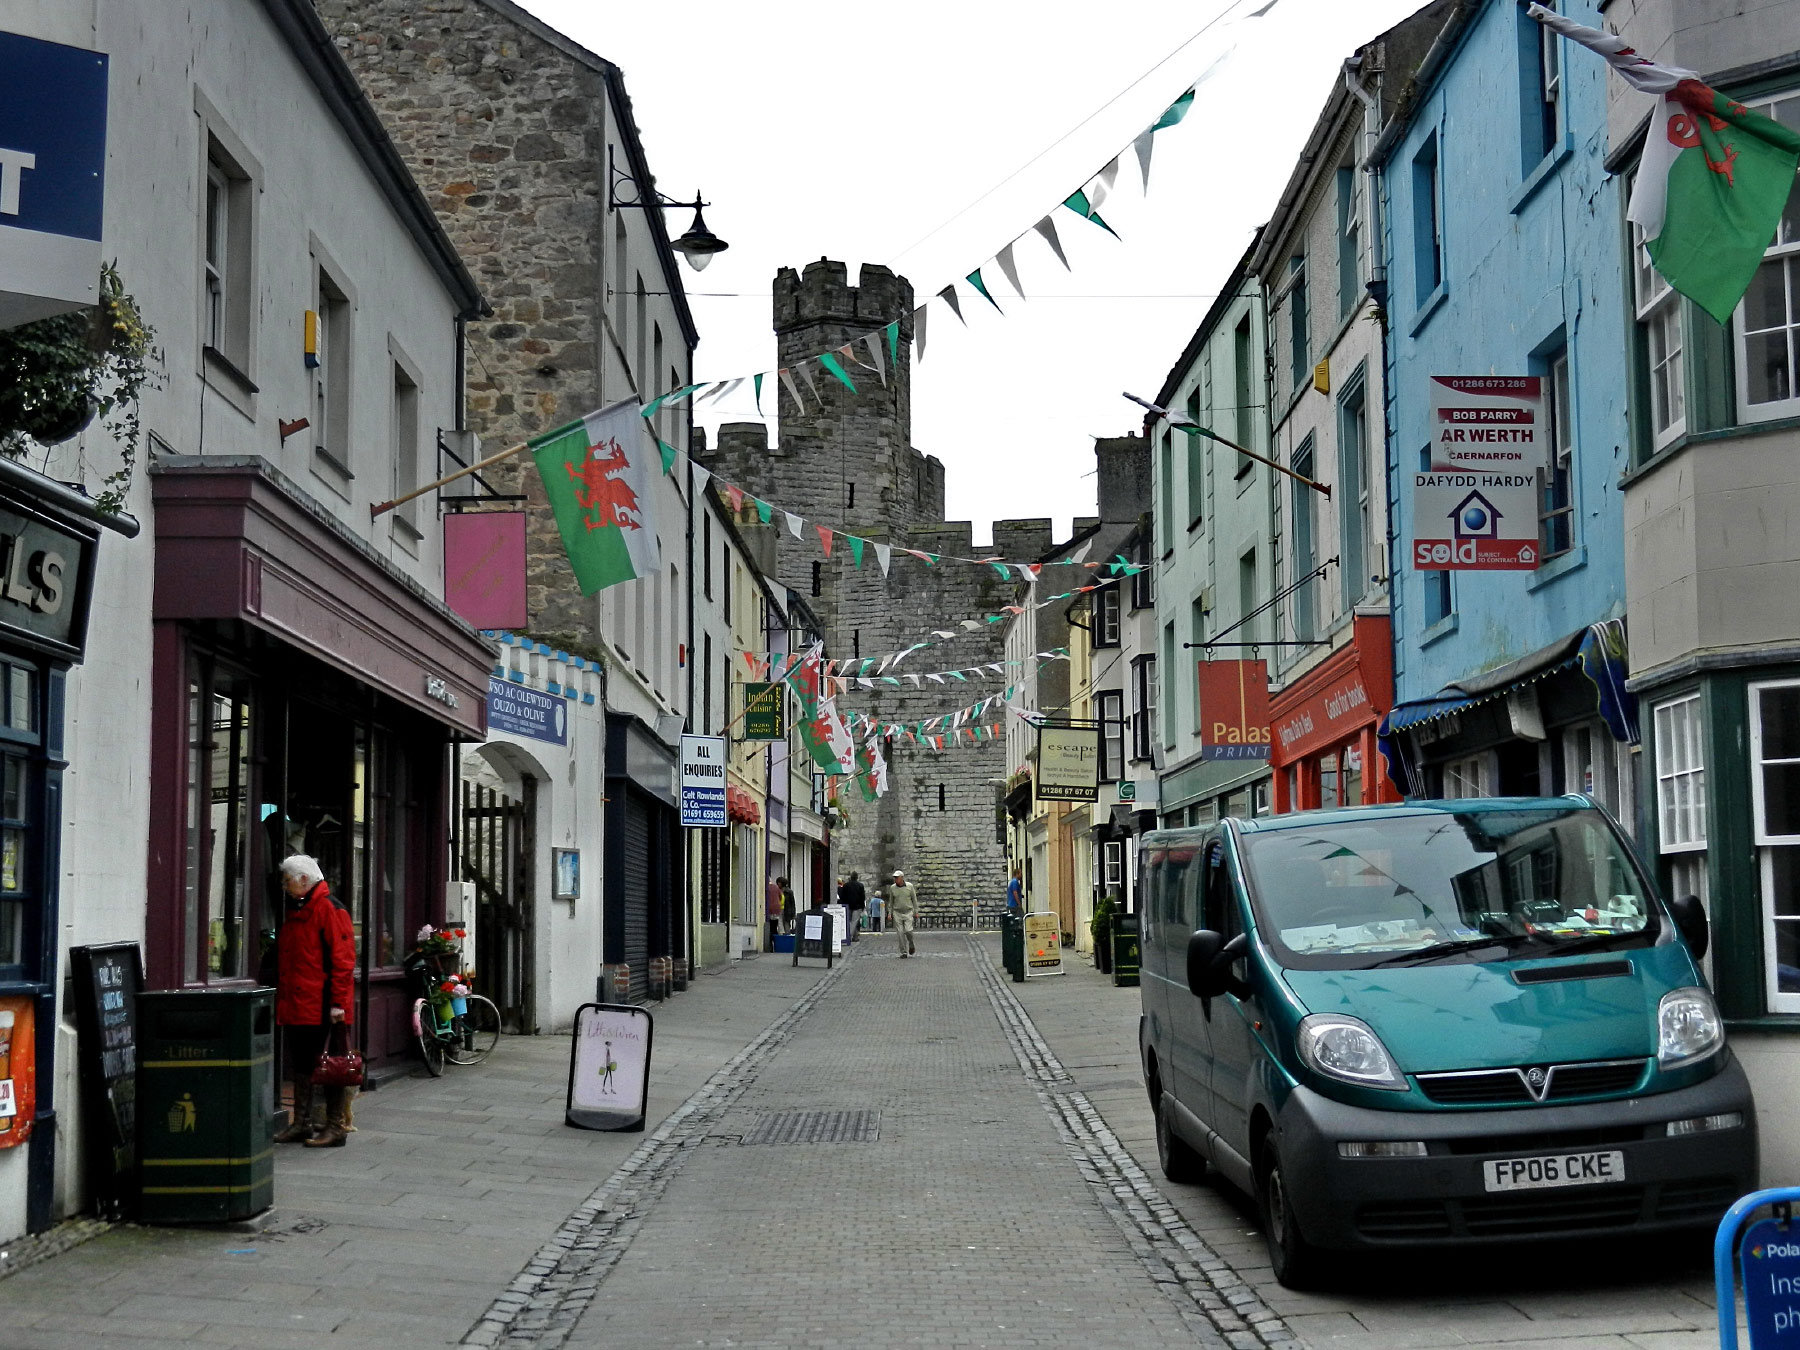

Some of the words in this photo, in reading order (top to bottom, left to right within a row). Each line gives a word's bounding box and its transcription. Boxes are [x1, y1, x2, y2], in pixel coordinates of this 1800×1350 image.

[1452, 380, 1485, 388] 01286
[1486, 380, 1506, 388] 673
[1507, 380, 1527, 388] 286
[1452, 411, 1477, 420] BOB
[1480, 411, 1518, 420] PARRY
[1440, 428, 1466, 443] AR
[1468, 429, 1534, 443] WERTH
[1449, 452, 1522, 460] CAERNARFON
[1416, 475, 1477, 487] DAFYDD
[1482, 475, 1534, 487] HARDY
[1417, 539, 1477, 564] sold
[0, 535, 66, 615] LS
[505, 686, 516, 700] AC
[517, 689, 553, 710] OLEWYDD
[1324, 690, 1342, 720] Good
[1347, 680, 1367, 708] books
[493, 698, 516, 715] OUZO
[516, 707, 523, 716] &
[523, 706, 545, 723] OLIVE
[1213, 722, 1271, 744] Palas
[697, 745, 710, 758] ALL
[1047, 744, 1097, 761] escape
[1215, 746, 1271, 758] PRINT
[683, 763, 723, 778] ENQUIRIES
[683, 790, 696, 800] Celt
[696, 791, 725, 801] Rowlands
[683, 800, 689, 808] &
[690, 800, 700, 809] Co.
[683, 809, 702, 818] 01691
[703, 810, 725, 819] 659659
[168, 1045, 209, 1058] Litter
[1494, 1157, 1559, 1185] FP06
[1565, 1153, 1613, 1179] CKE
